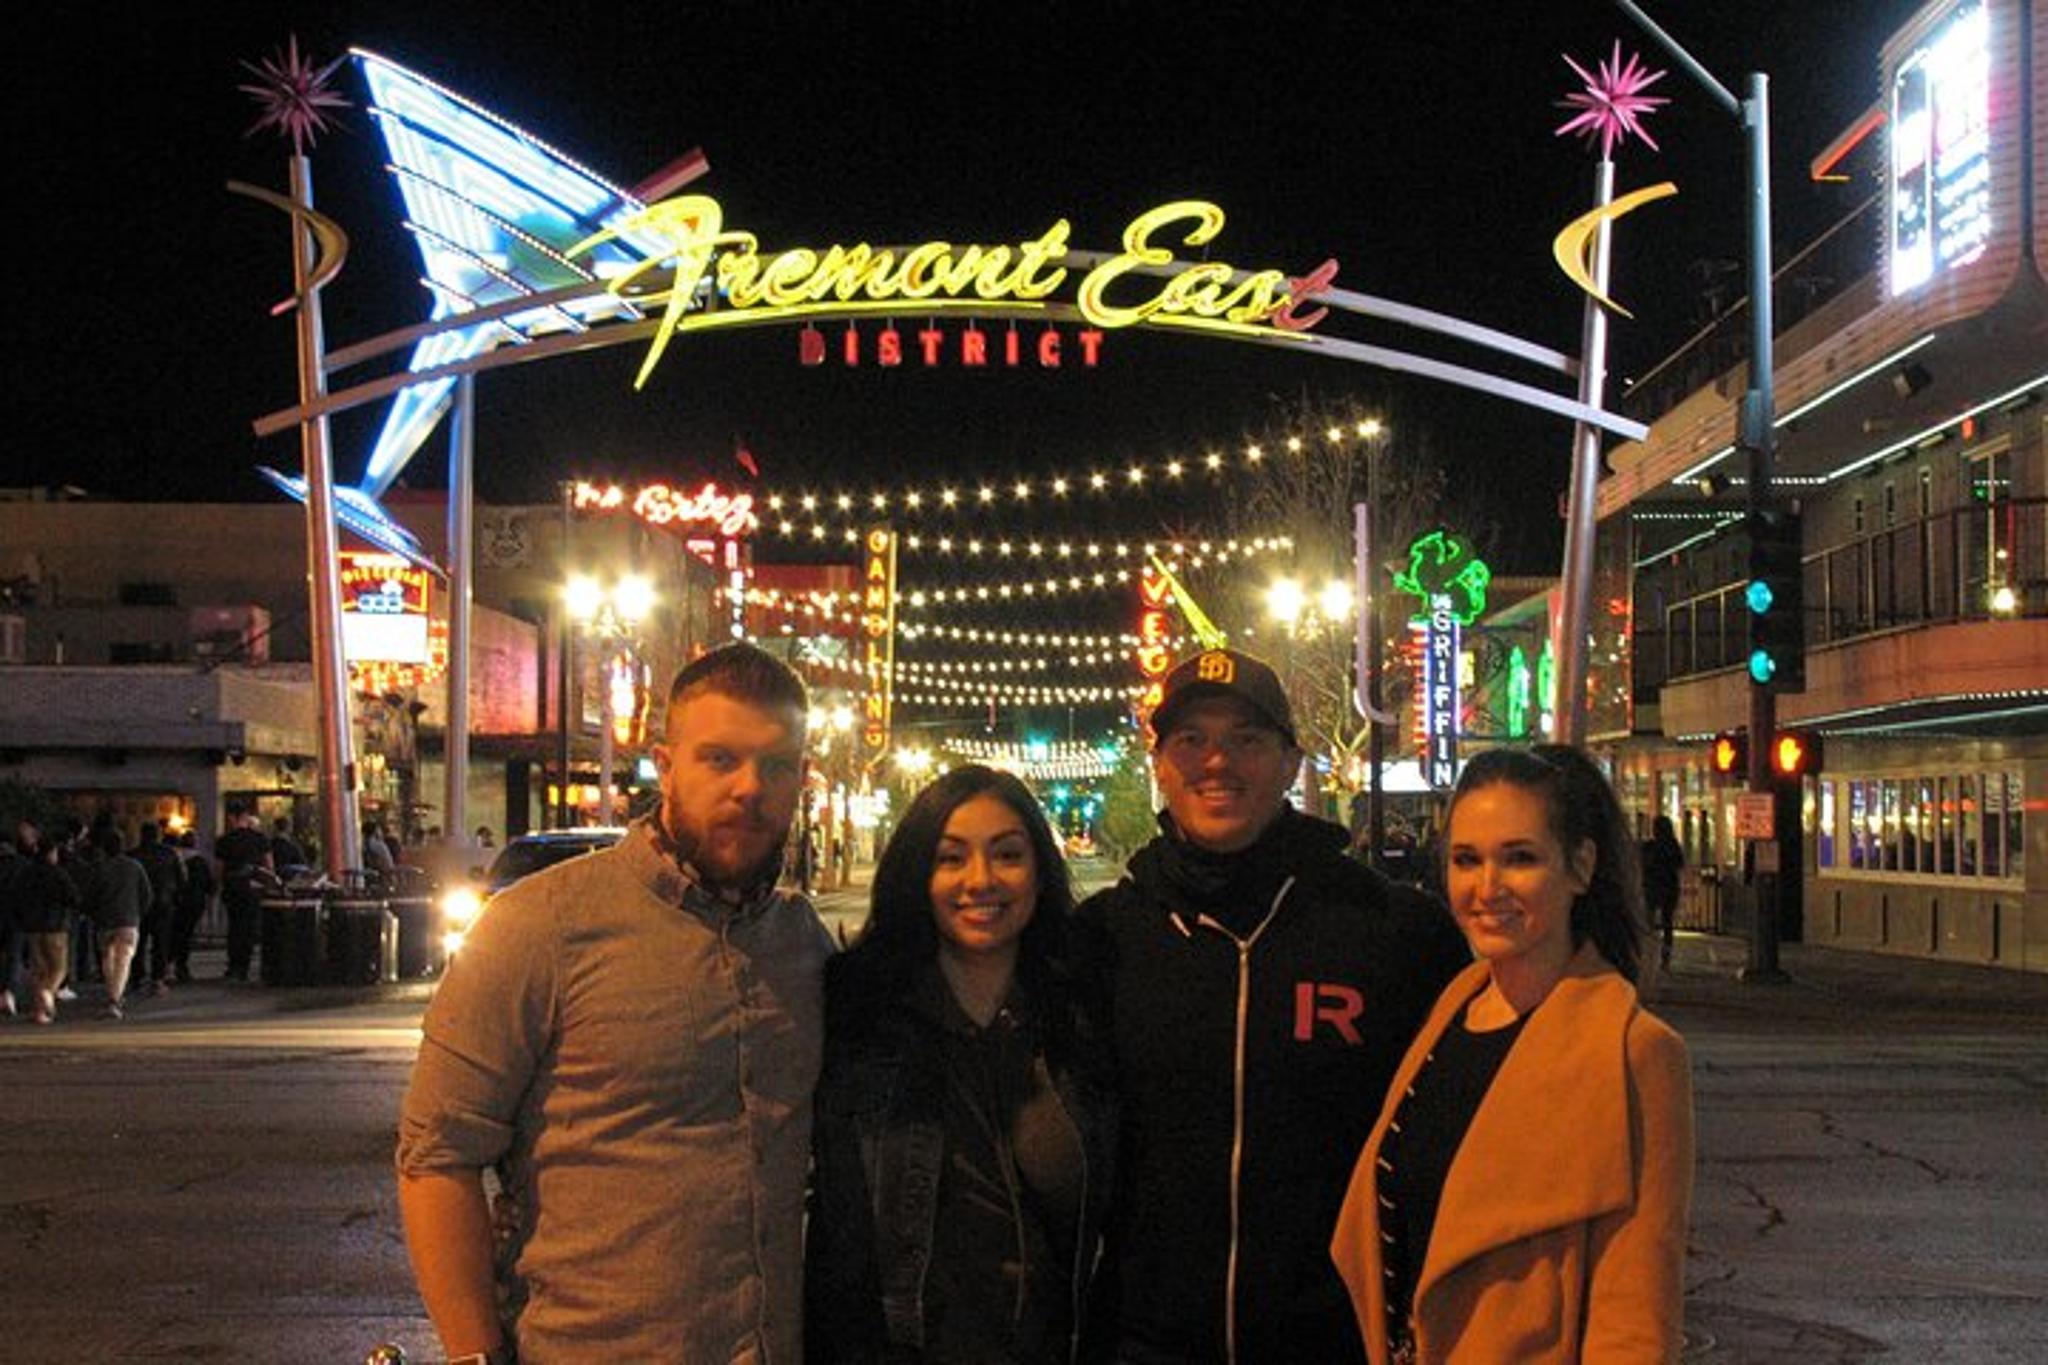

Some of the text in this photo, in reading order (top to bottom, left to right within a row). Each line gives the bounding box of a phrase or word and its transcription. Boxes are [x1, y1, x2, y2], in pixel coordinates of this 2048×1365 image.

[563, 194, 1339, 391] Fremont East
[800, 329, 1104, 367] DISTRICT
[866, 530, 888, 746] GAMBLING
[1432, 611, 1453, 786] GRIFFIN
